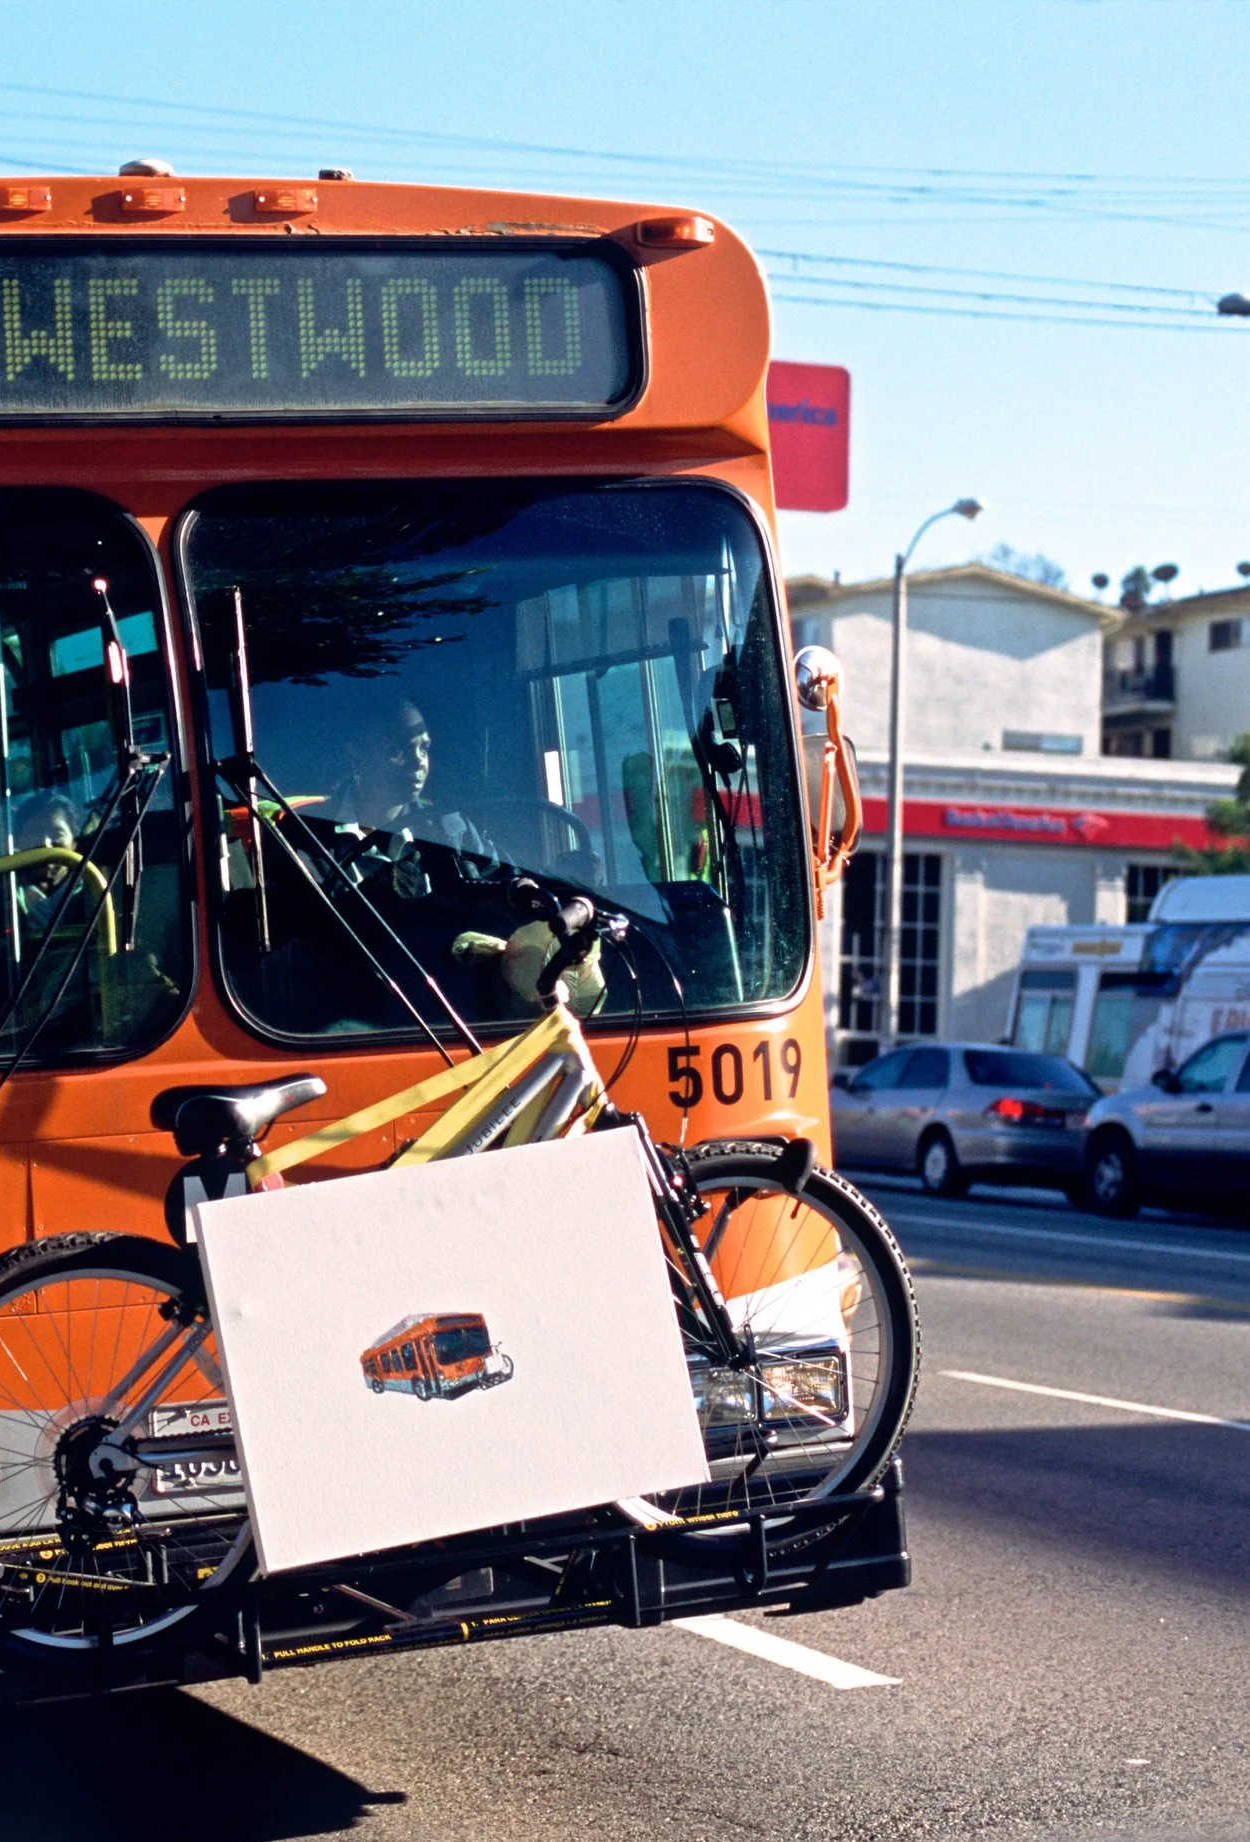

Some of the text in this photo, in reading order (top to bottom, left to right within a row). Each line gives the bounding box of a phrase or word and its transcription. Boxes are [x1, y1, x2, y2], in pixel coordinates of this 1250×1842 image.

[3, 277, 580, 381] WESTWOOD
[667, 1038, 802, 1109] 5019
[466, 1097, 521, 1154] JUBILEE
[190, 1414, 210, 1427] CA
[274, 1649, 296, 1660] PULL
[297, 1642, 330, 1656] HANDLE
[332, 1640, 344, 1649] TO
[345, 1638, 368, 1649] FOLD
[368, 1634, 392, 1645] RACK
